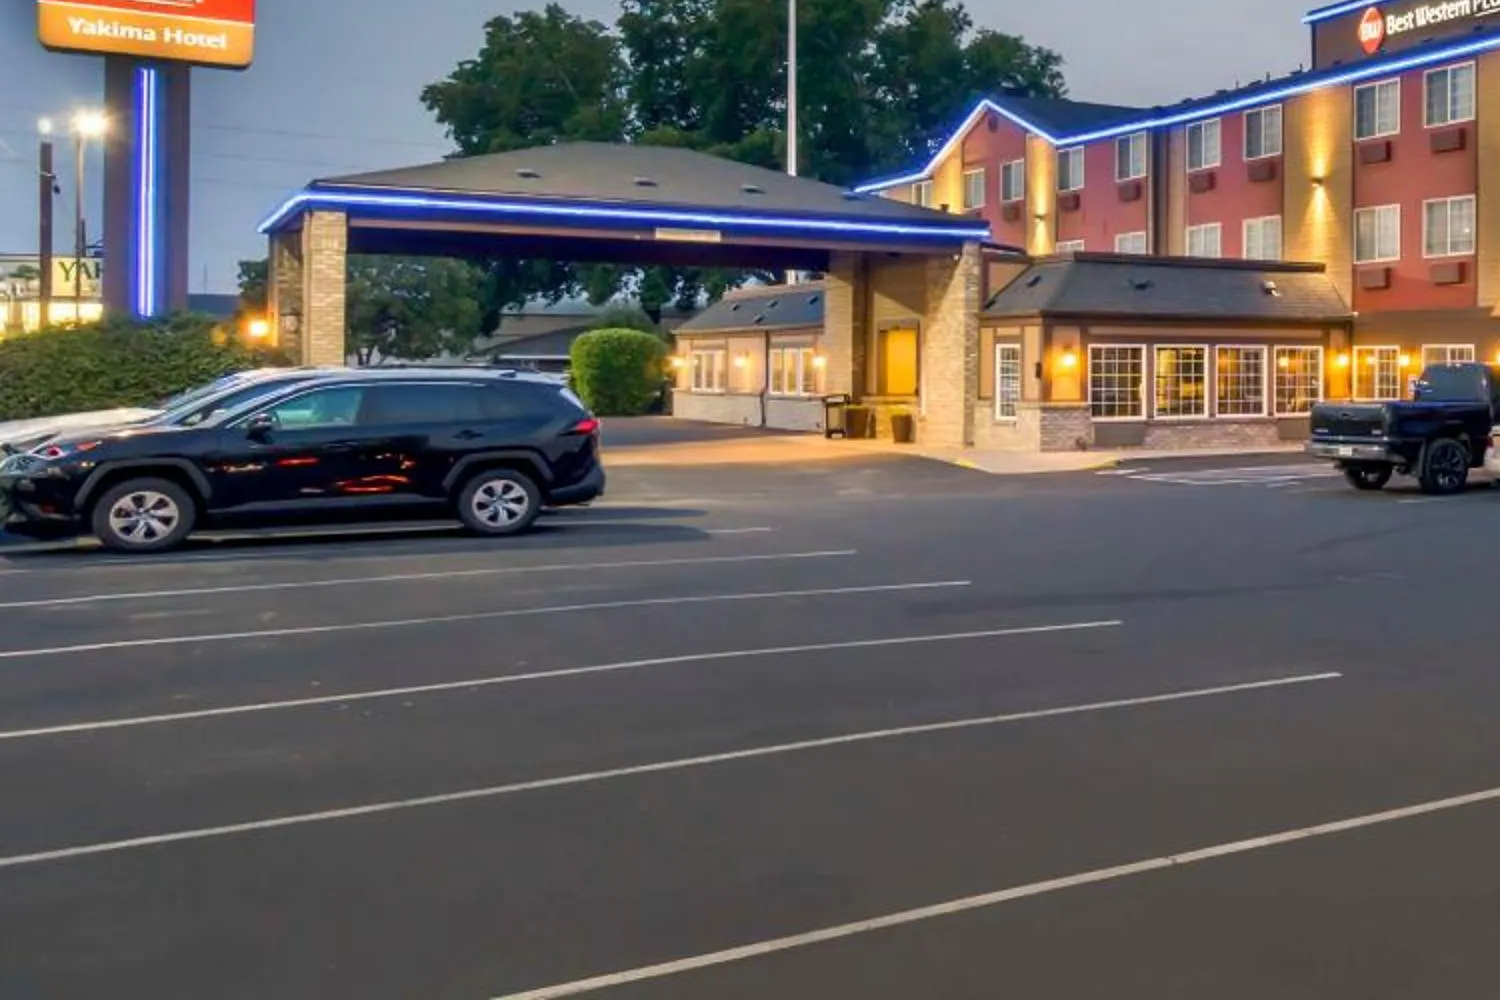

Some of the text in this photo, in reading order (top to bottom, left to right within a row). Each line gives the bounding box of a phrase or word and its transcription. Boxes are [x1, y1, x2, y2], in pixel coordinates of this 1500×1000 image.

[67, 15, 227, 50] Yakima Hotel
[1386, 12, 1414, 36] Best
